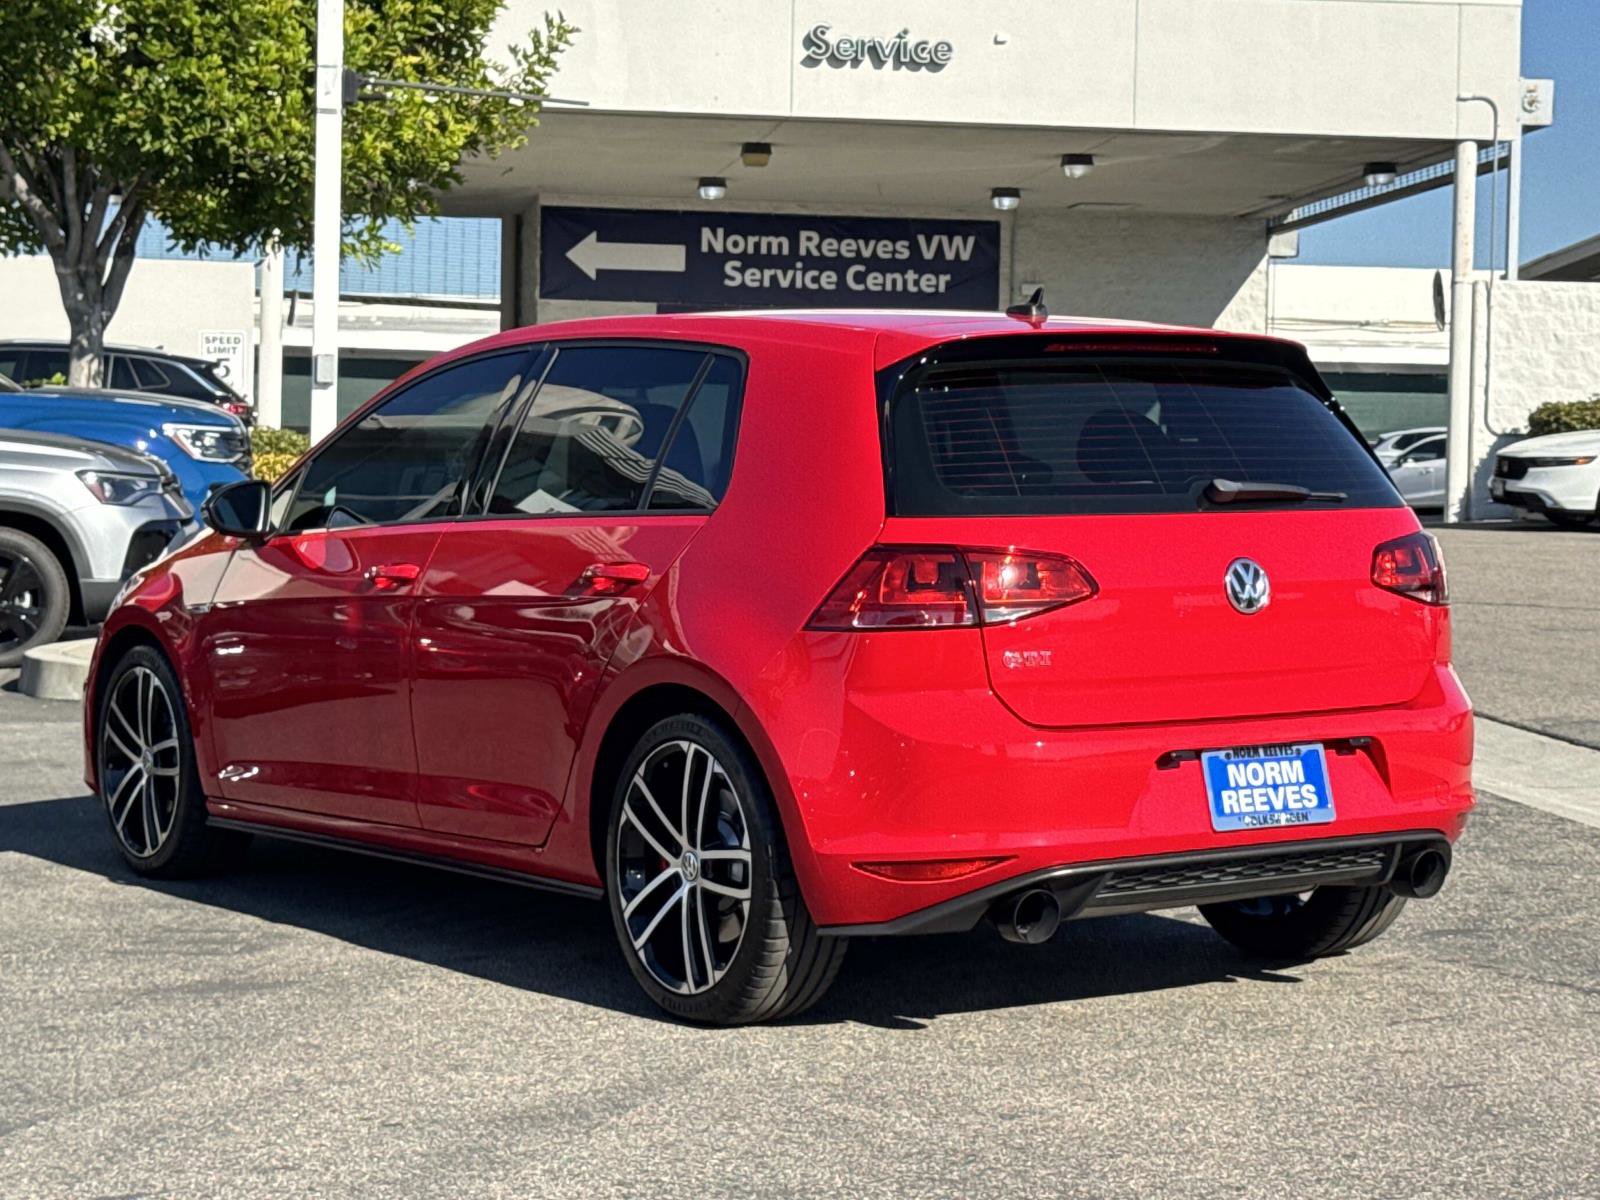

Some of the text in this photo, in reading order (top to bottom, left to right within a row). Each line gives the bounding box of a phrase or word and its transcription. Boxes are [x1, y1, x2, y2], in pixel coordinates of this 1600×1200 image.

[801, 23, 954, 73] Service
[700, 226, 976, 261] Norm Reeves VW
[723, 260, 952, 293] Service Center
[204, 336, 241, 345] SPEED
[206, 346, 237, 354] LIMIT
[1232, 744, 1294, 759] NORM REEVES
[1226, 759, 1305, 788] NORM
[1221, 784, 1318, 814] REEVES
